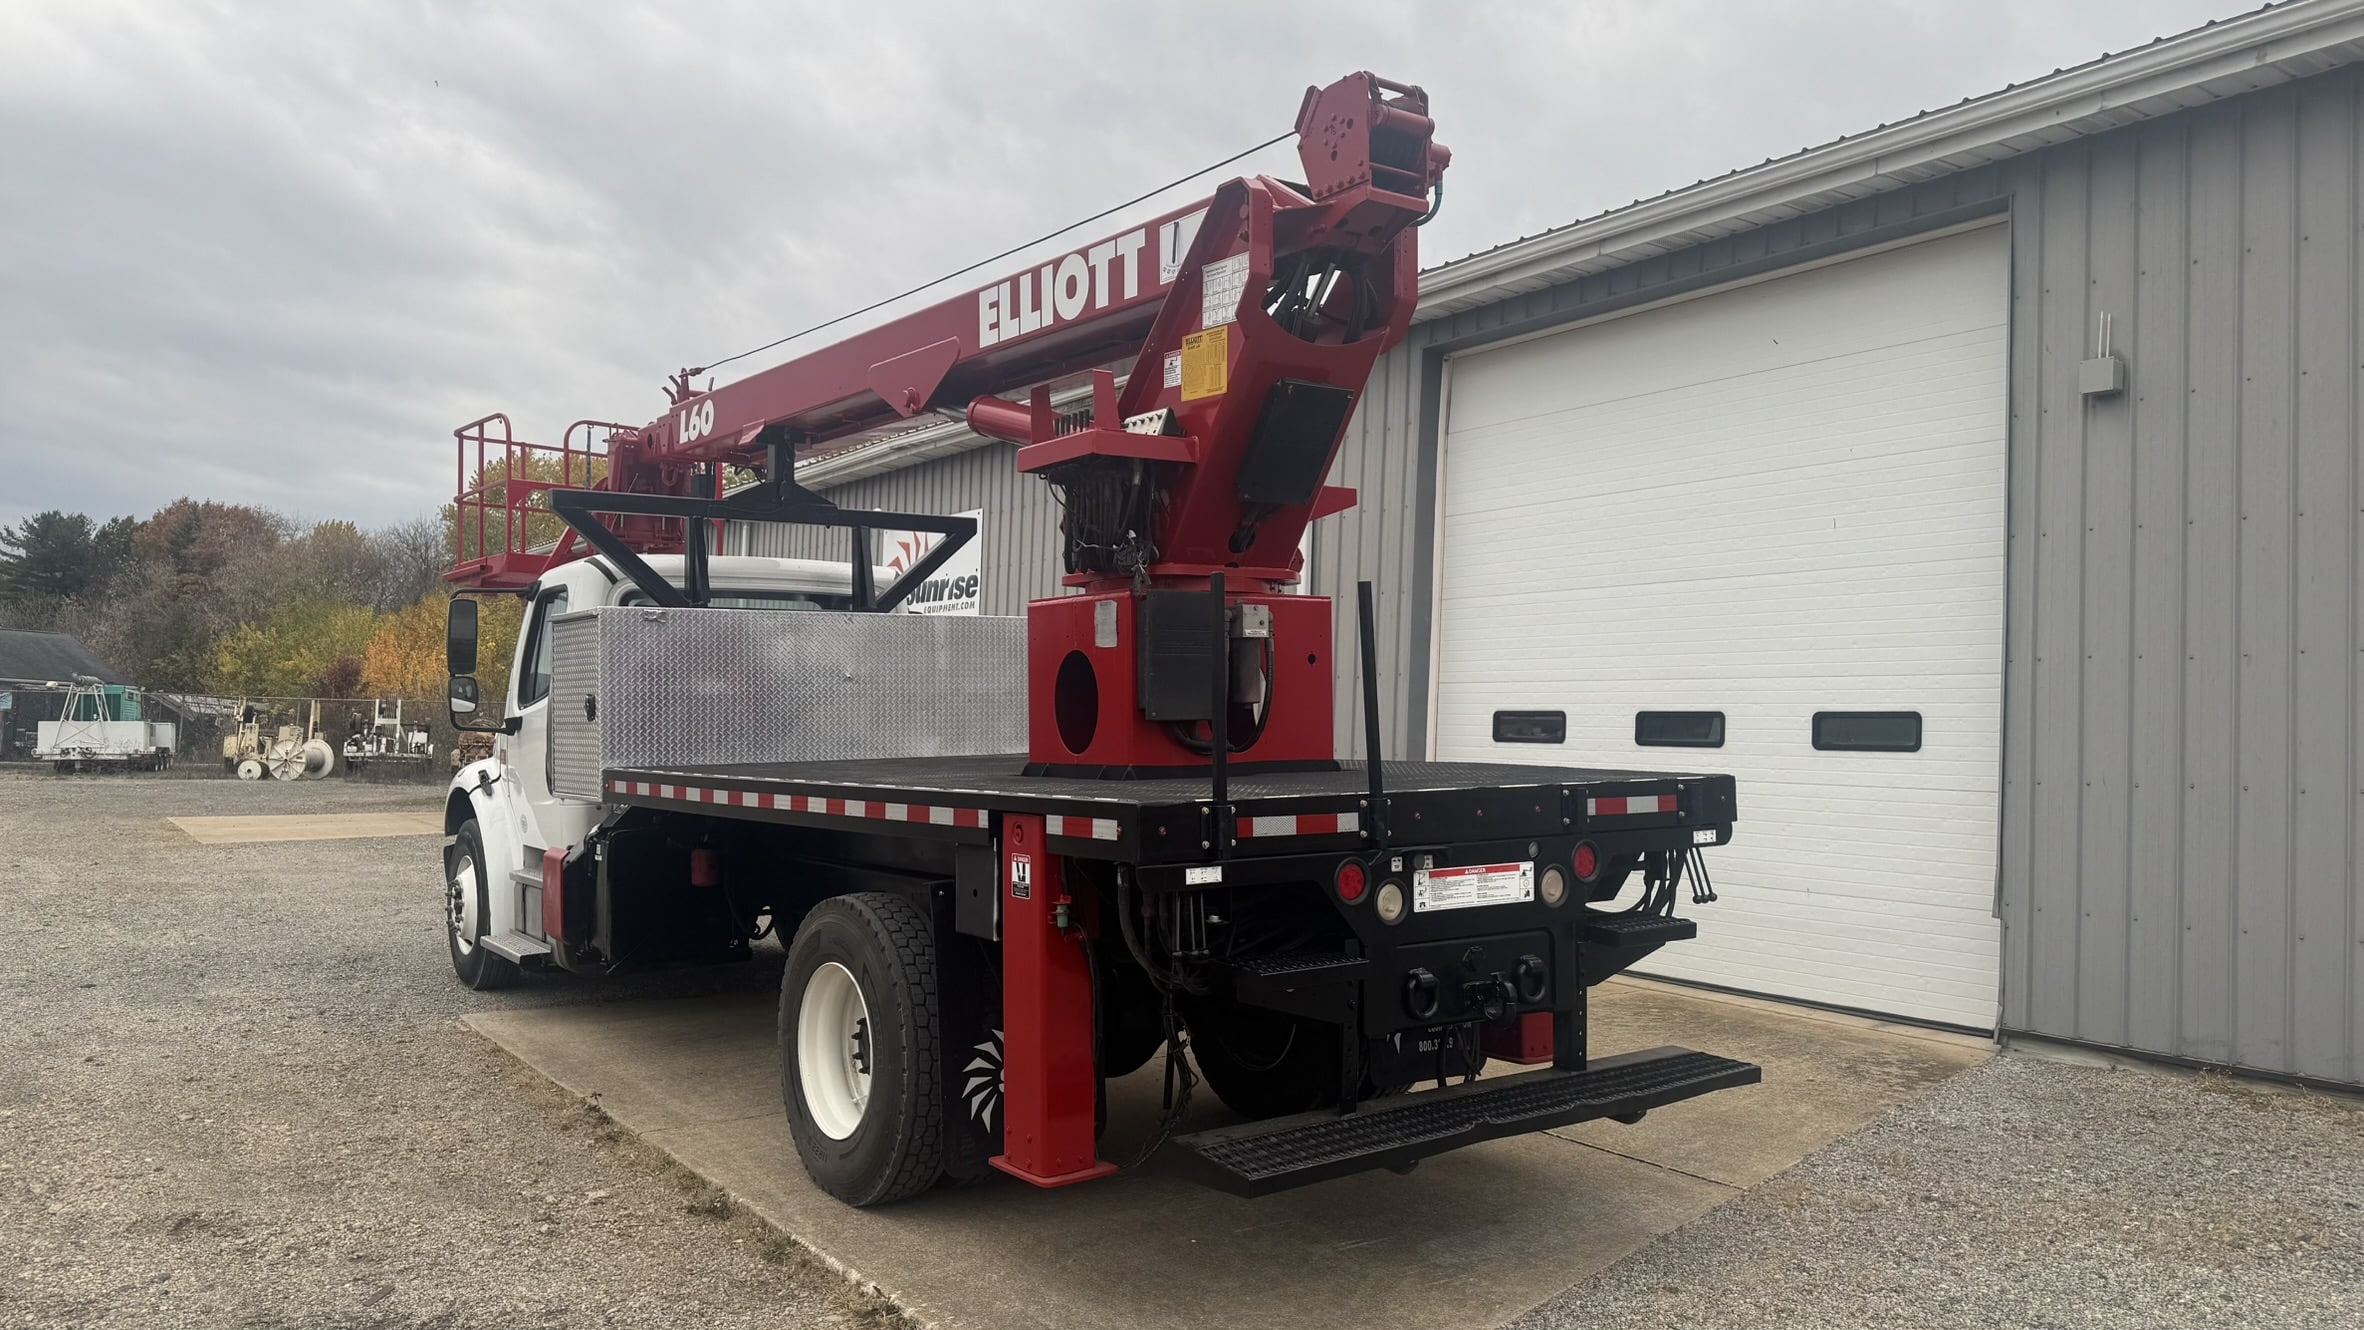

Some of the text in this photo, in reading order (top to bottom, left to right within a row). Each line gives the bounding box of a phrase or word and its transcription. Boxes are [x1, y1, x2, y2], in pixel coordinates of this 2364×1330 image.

[979, 228, 1145, 348] ELLIOTT
[679, 399, 714, 444] L60
[923, 601, 975, 614] EQUIPMENT.COM
